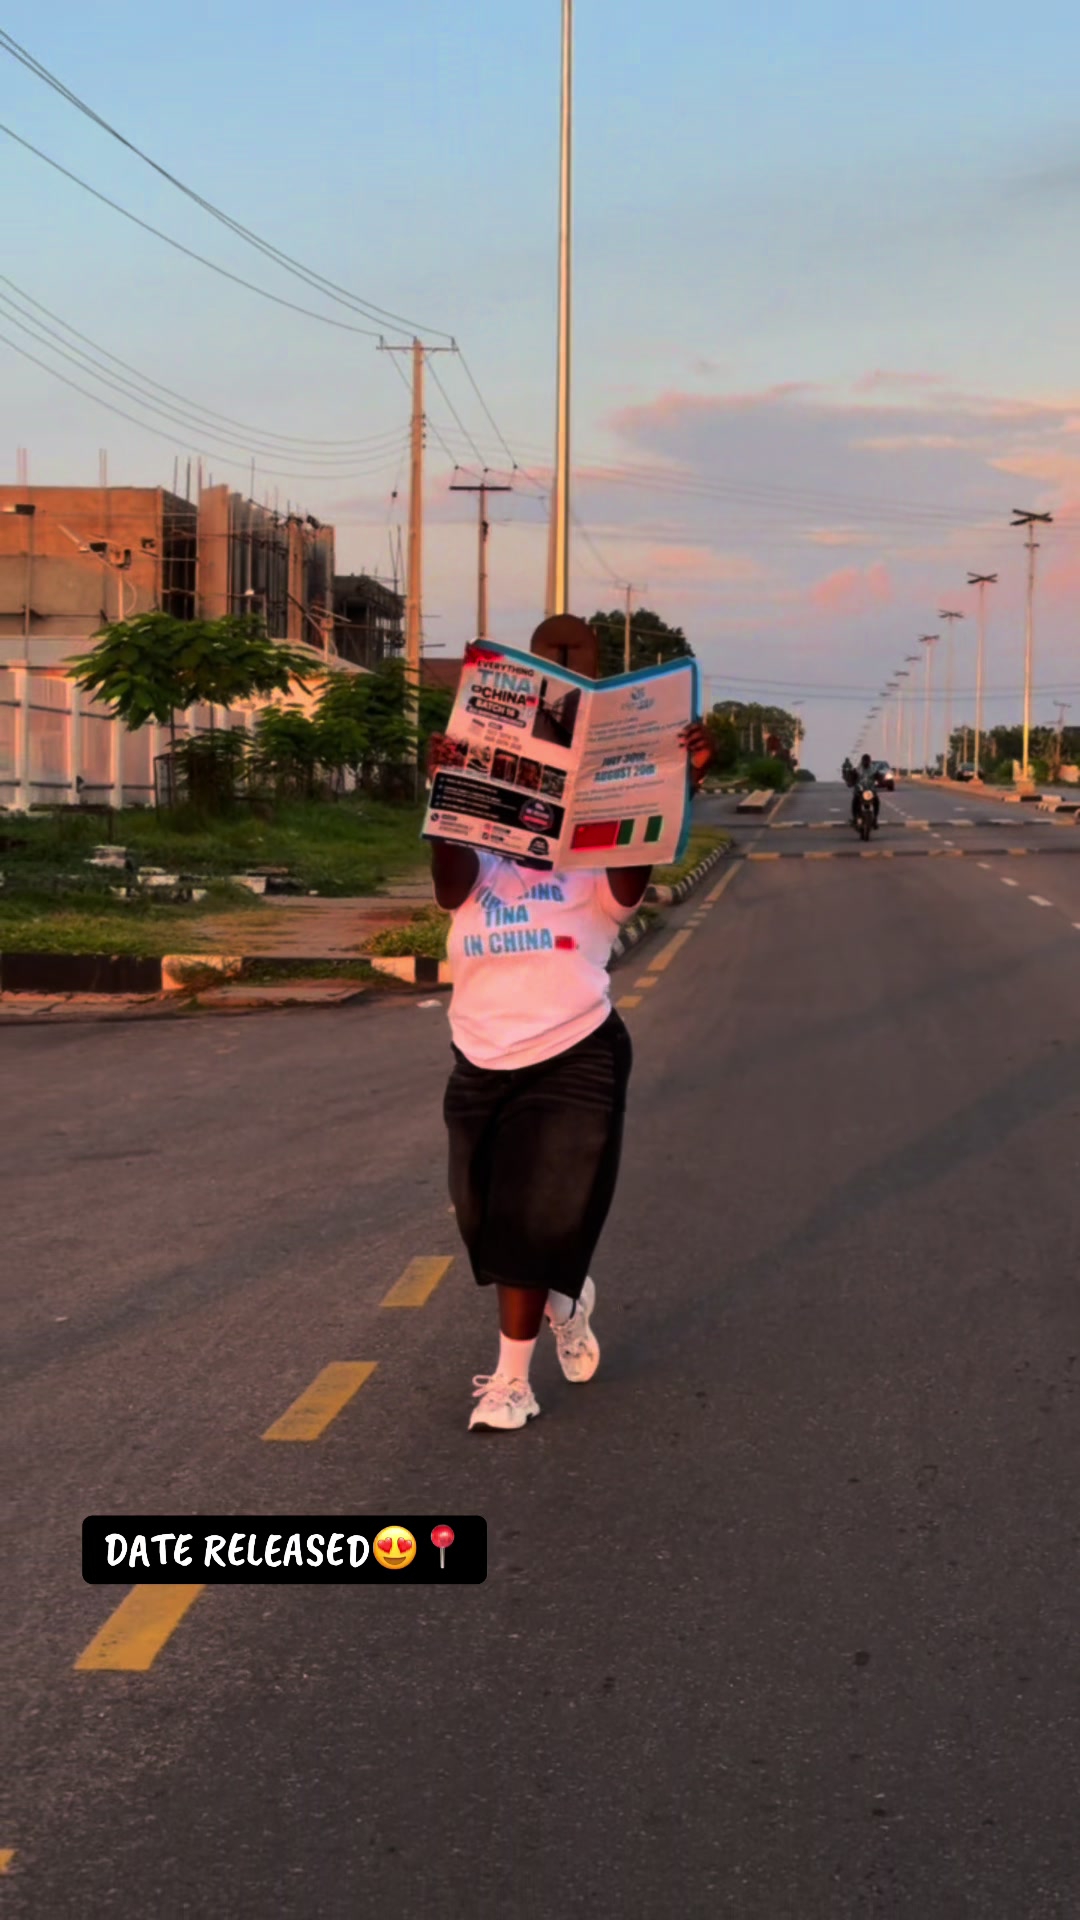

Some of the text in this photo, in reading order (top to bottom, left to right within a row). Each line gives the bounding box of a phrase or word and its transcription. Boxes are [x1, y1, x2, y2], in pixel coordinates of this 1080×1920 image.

[478, 661, 534, 677] EVERYTHING
[477, 668, 531, 693] TINA
[482, 686, 526, 706] CHINA
[594, 766, 631, 781] AUGUST
[484, 904, 529, 928] TINA
[463, 928, 553, 957] IN CHINA
